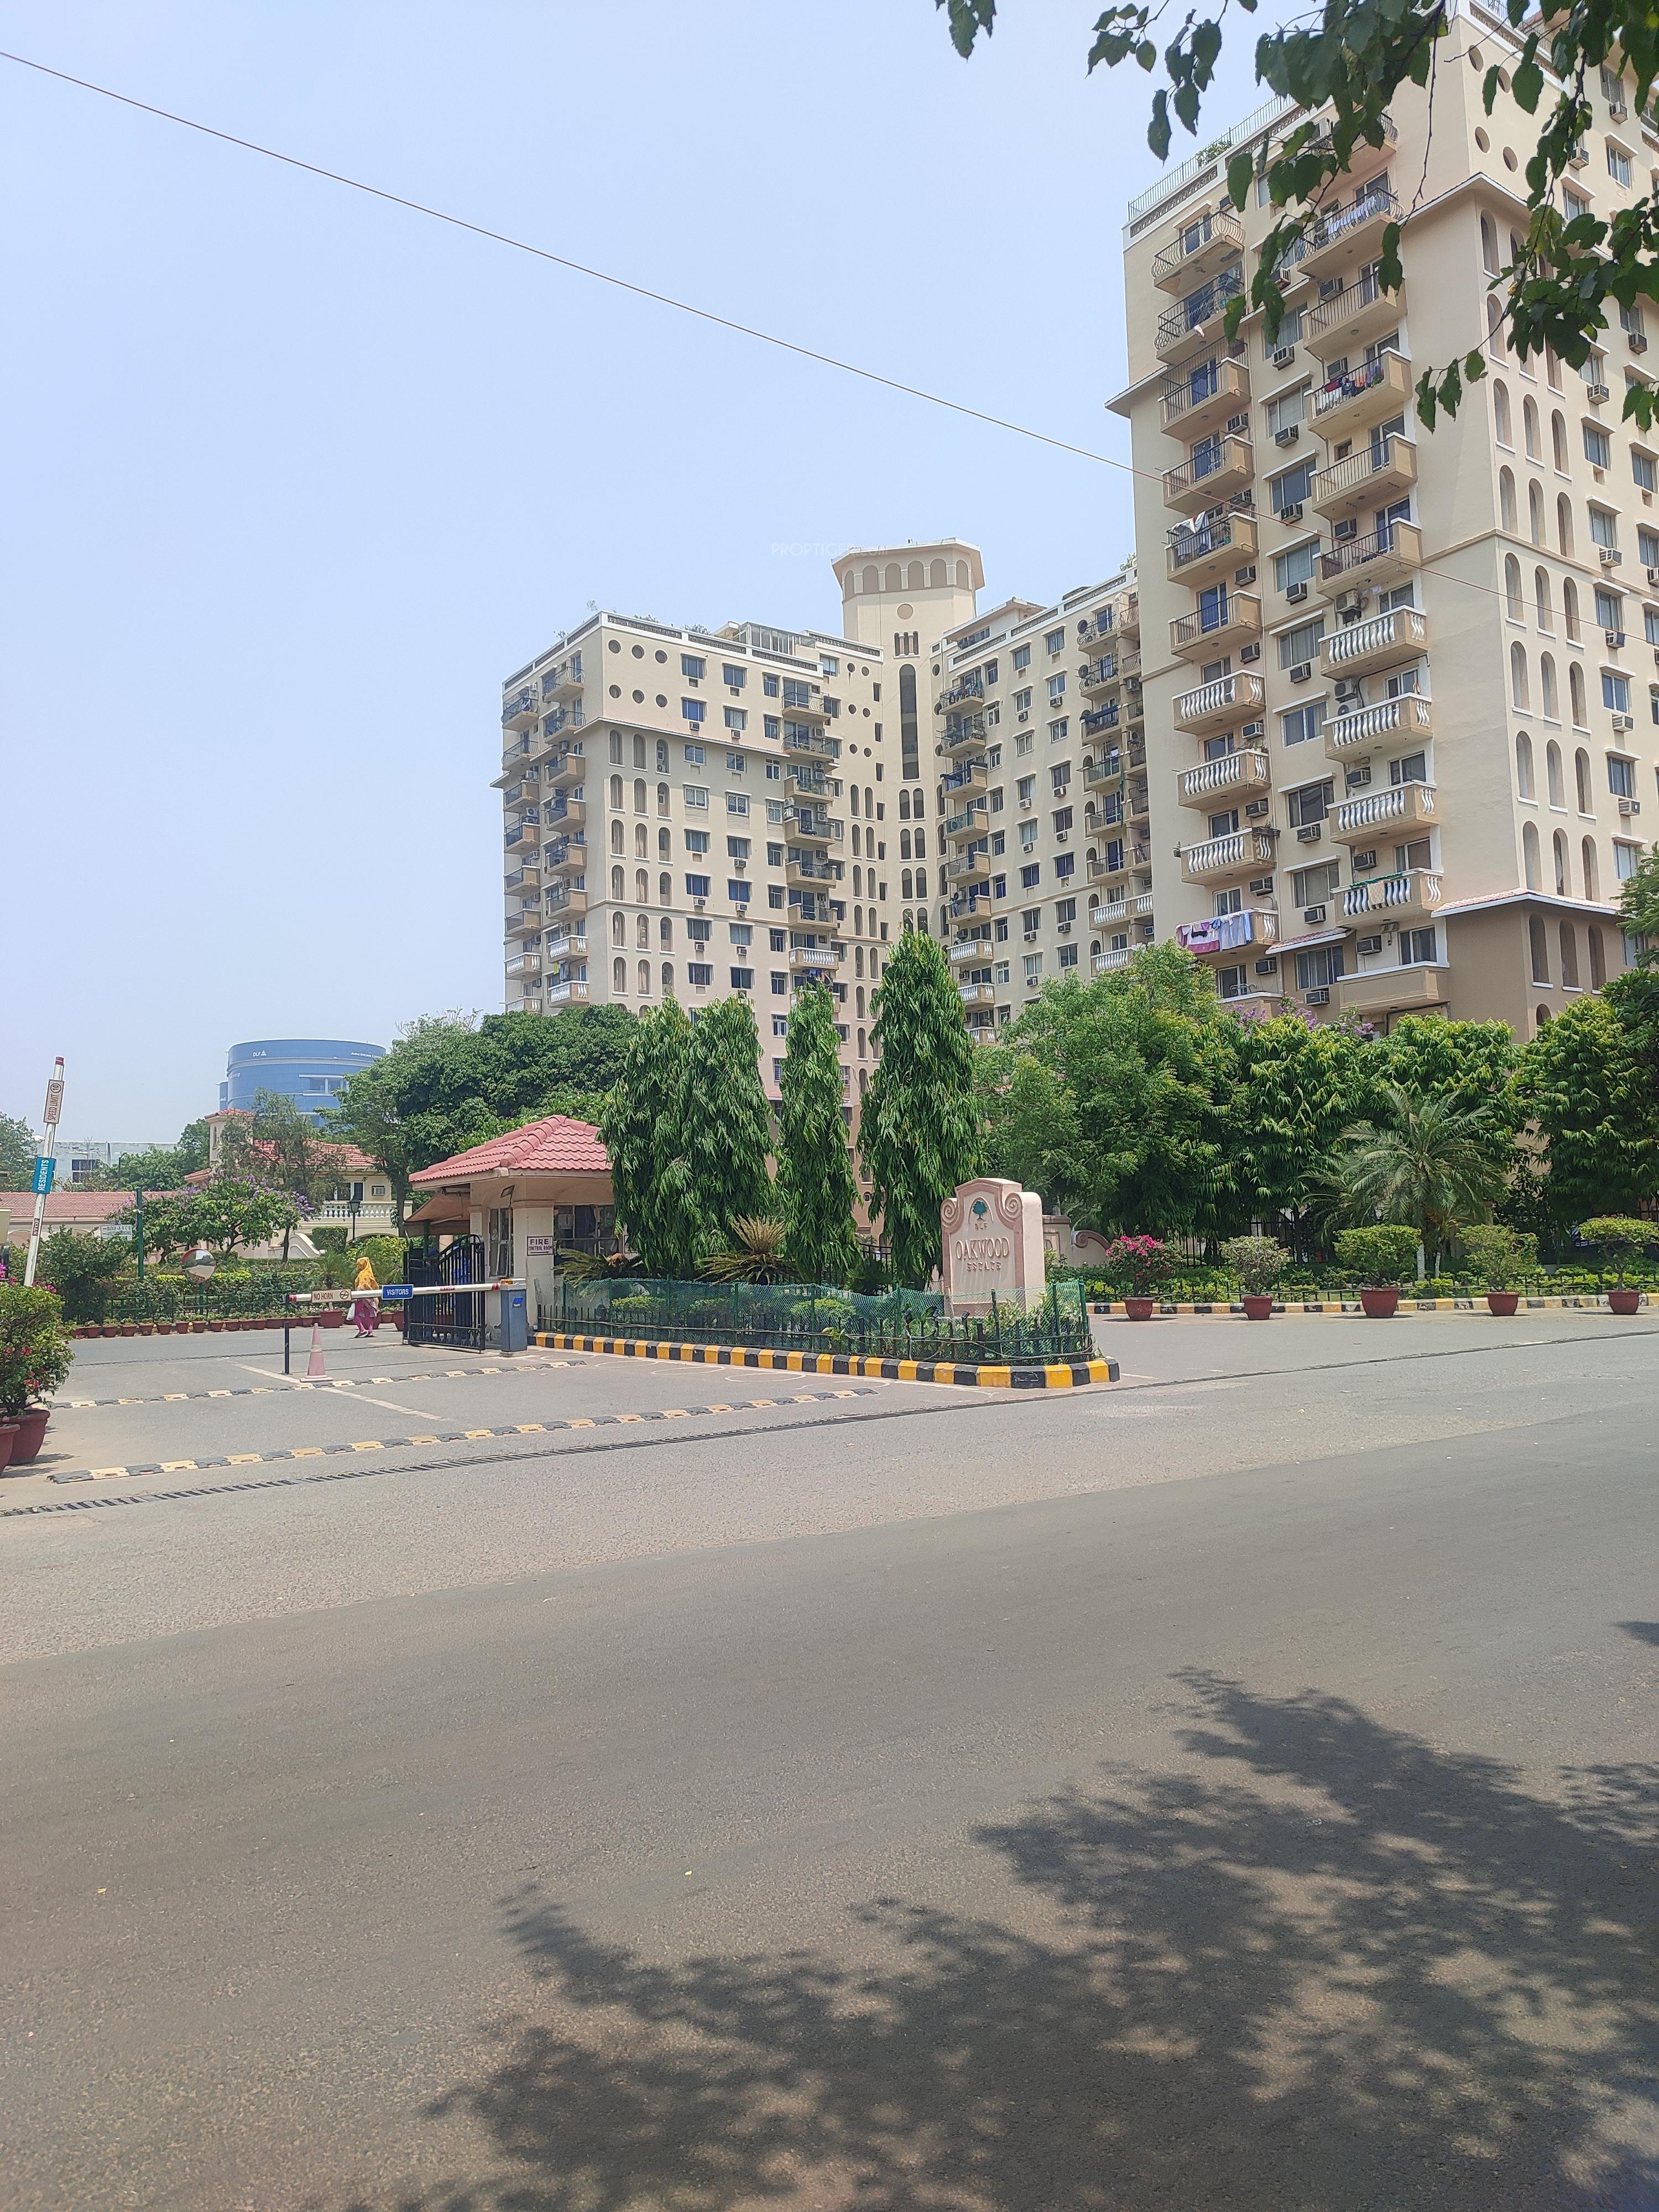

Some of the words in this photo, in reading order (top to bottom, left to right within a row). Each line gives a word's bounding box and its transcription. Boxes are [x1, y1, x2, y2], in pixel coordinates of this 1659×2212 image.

[49, 1093, 59, 1107] LIMIT
[47, 1107, 58, 1121] SPEED
[38, 1159, 49, 1191] RESIDENTS
[974, 1222, 988, 1230] DLF
[956, 1237, 1010, 1260] OAKWOOD
[967, 1261, 1001, 1271] ESTATE
